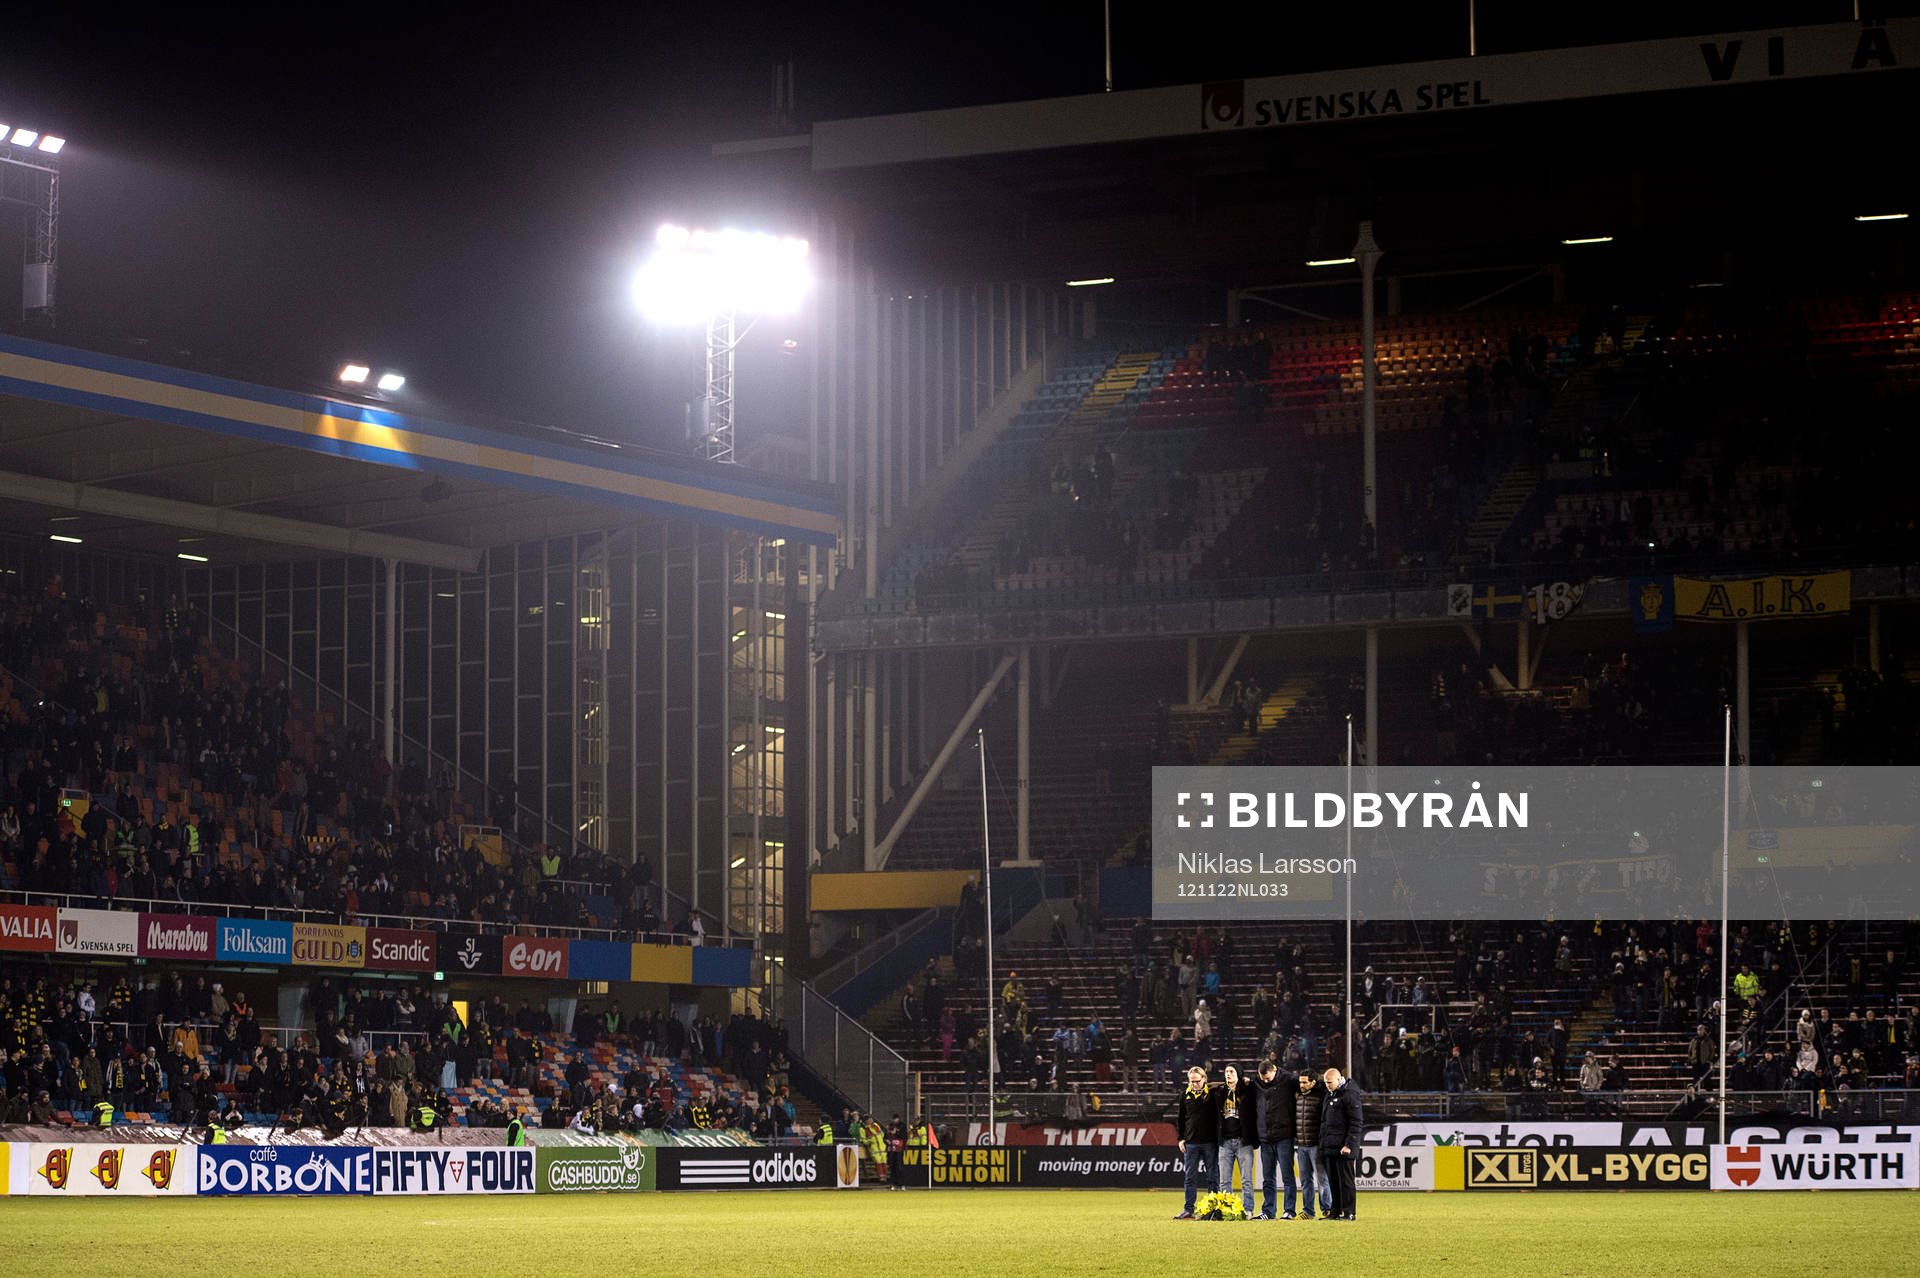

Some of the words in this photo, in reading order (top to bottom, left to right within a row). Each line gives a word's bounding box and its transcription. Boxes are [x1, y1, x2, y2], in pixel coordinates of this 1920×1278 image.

[1255, 88, 1403, 126] SVENSKA
[1416, 81, 1490, 111] SPEL
[1696, 578, 1826, 617] A.I.K.
[0, 915, 53, 940] VALIA
[147, 920, 208, 953] Marabou
[295, 926, 344, 938] NORRLANDS
[80, 941, 114, 951] SVENSKA
[117, 943, 135, 953] SPEL
[224, 927, 287, 955] Folksam
[293, 939, 344, 962] GULD
[372, 938, 430, 963] Scandic
[465, 937, 475, 953] SJ
[753, 1152, 816, 1183] adidas
[903, 1150, 1005, 1166] WESTERN
[1038, 1158, 1091, 1175] moving
[1095, 1161, 1145, 1176] money
[1148, 1157, 1170, 1173] for
[1473, 1154, 1531, 1181] XL
[1523, 1153, 1532, 1174] BYGG
[1543, 1153, 1708, 1182] XL-BYGG
[1771, 1152, 1903, 1181] WÜRTH
[201, 1152, 370, 1192] BORBONE
[376, 1151, 450, 1192] FIFTY
[467, 1151, 533, 1191] FOUR
[933, 1167, 1005, 1183] UNION
